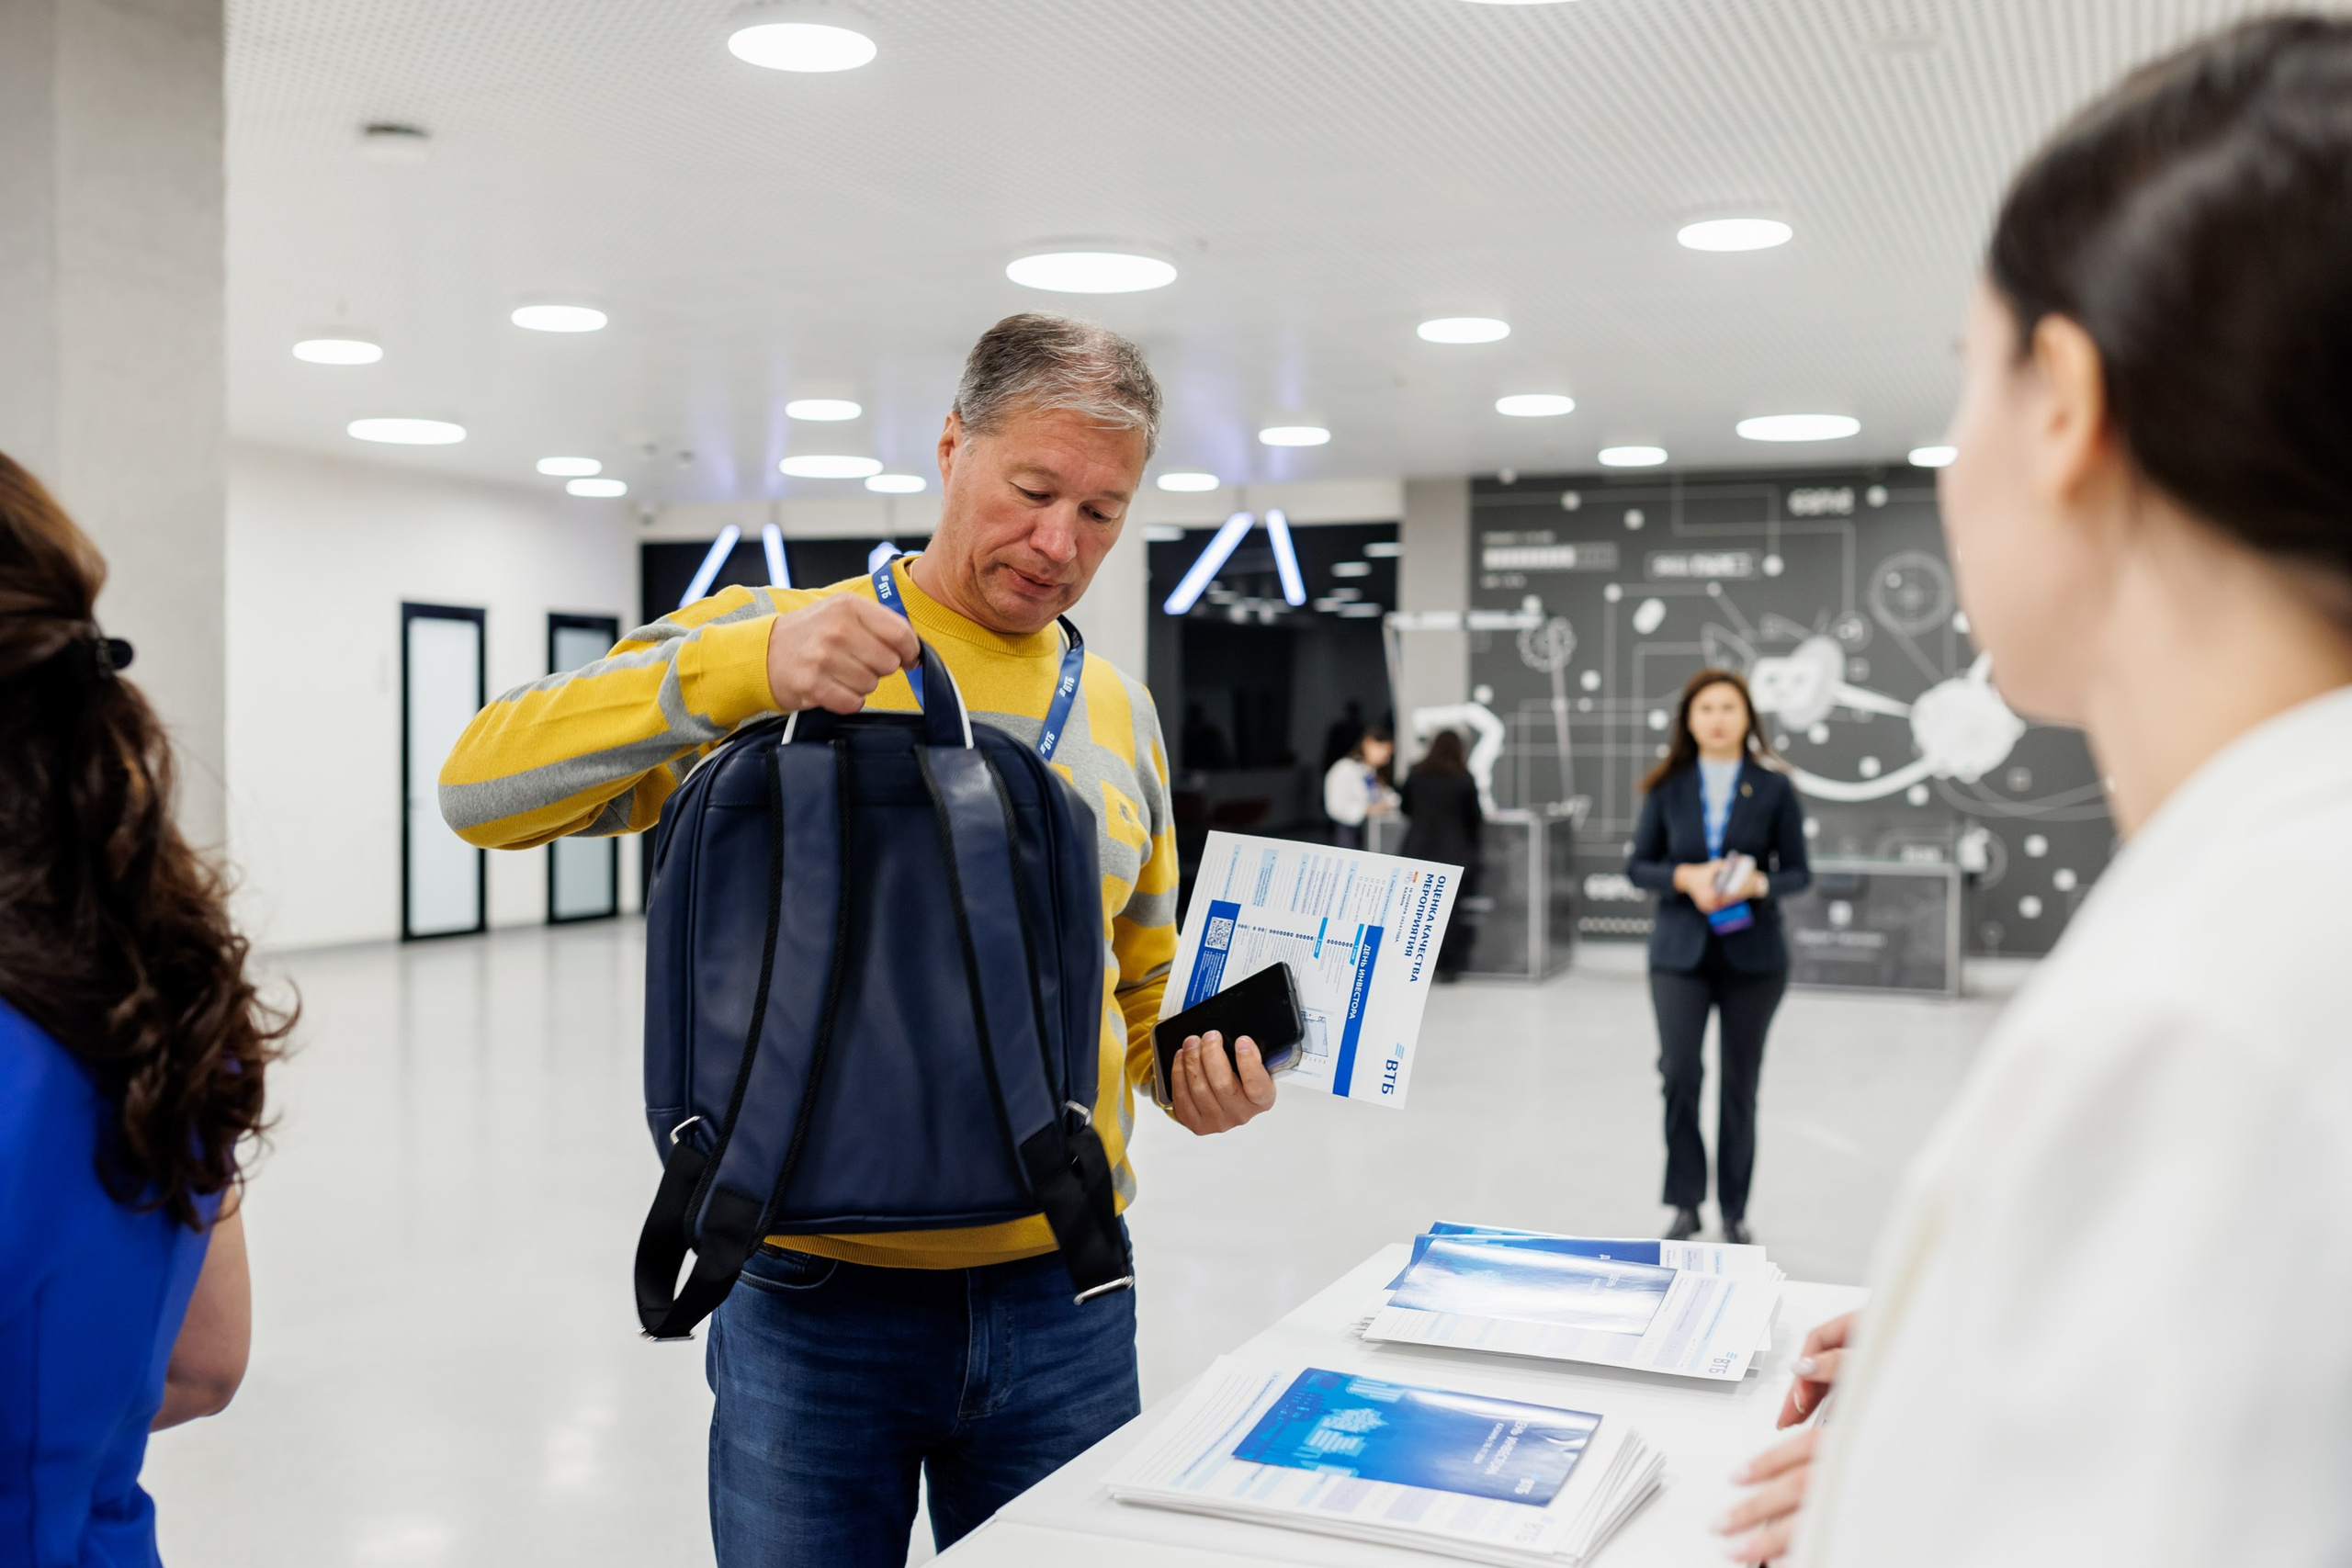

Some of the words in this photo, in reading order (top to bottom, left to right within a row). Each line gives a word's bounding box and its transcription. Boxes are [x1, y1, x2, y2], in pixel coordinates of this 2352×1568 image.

[877, 581, 892, 600] ВТБ
[1063, 675, 1075, 694] ВТБ
[1044, 731, 1056, 751] ВТБ
[1399, 886, 1408, 906] КАЗАНЬ
[1402, 894, 1411, 914] НОЯБРЯ
[1426, 874, 1446, 922] ОЦЕНКА
[1404, 873, 1433, 956] МЕРОПРИЯТИЯ
[1359, 943, 1371, 967] ДЕНЬ
[1409, 924, 1431, 983] КАЧЕСТВА
[1348, 968, 1365, 1020] ИНВЕСТОРА
[1381, 1059, 1398, 1095] ВТБ
[1708, 1358, 1730, 1373] ВТБ
[1513, 1478, 1534, 1495] ВТБ
